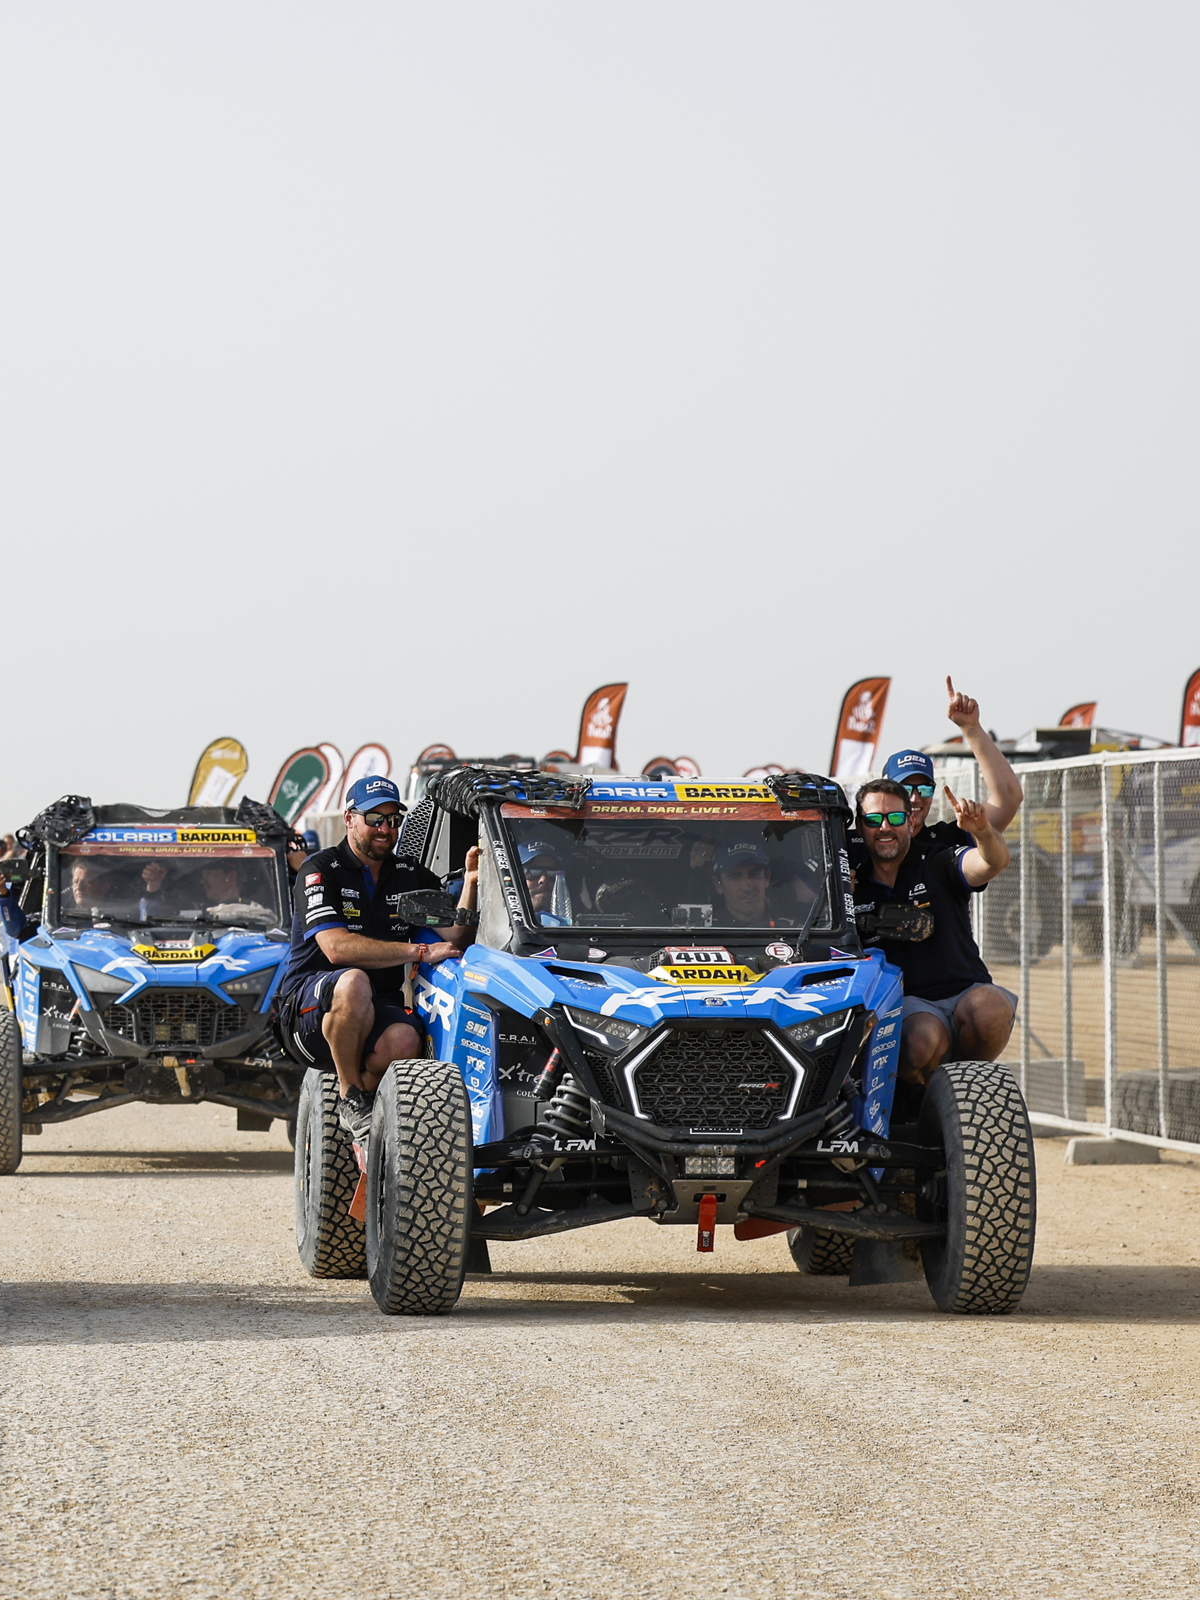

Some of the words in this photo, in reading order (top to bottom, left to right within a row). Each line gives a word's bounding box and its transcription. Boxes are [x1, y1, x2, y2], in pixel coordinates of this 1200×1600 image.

[82, 832, 173, 842] POLARIS
[181, 832, 252, 842] BARDAHL
[676, 952, 727, 963] 401
[499, 1033, 537, 1043] C.R.A.I.
[461, 1038, 491, 1056] sparco
[467, 1055, 486, 1072] FOX
[554, 1139, 596, 1151] LFM
[817, 1140, 859, 1153] LFM
